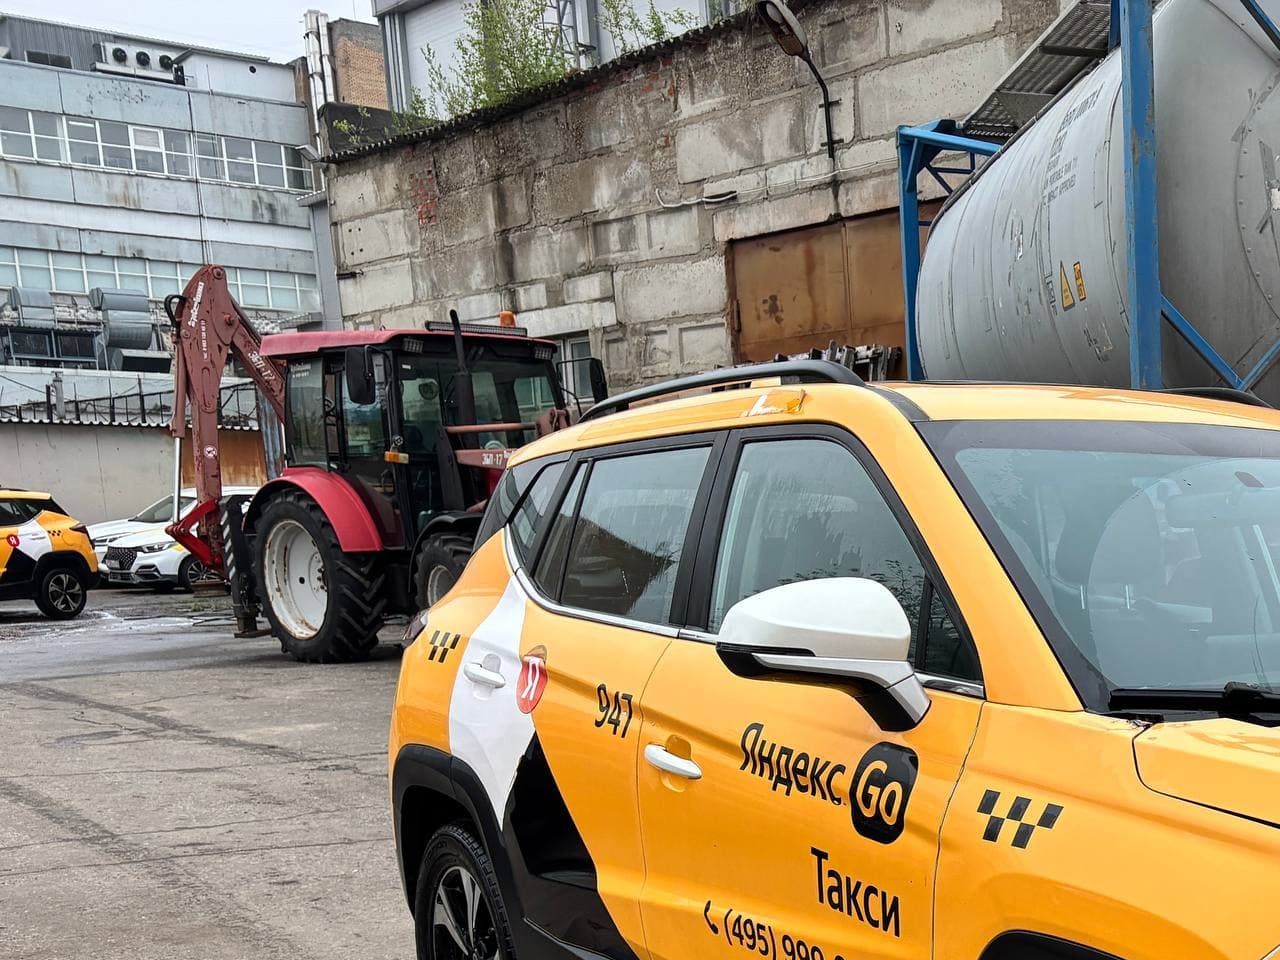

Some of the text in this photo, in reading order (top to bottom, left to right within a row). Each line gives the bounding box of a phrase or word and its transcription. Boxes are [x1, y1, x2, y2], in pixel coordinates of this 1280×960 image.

[594, 683, 634, 739] 947
[739, 722, 904, 827] Яндекс Go
[810, 845, 901, 938] Такси
